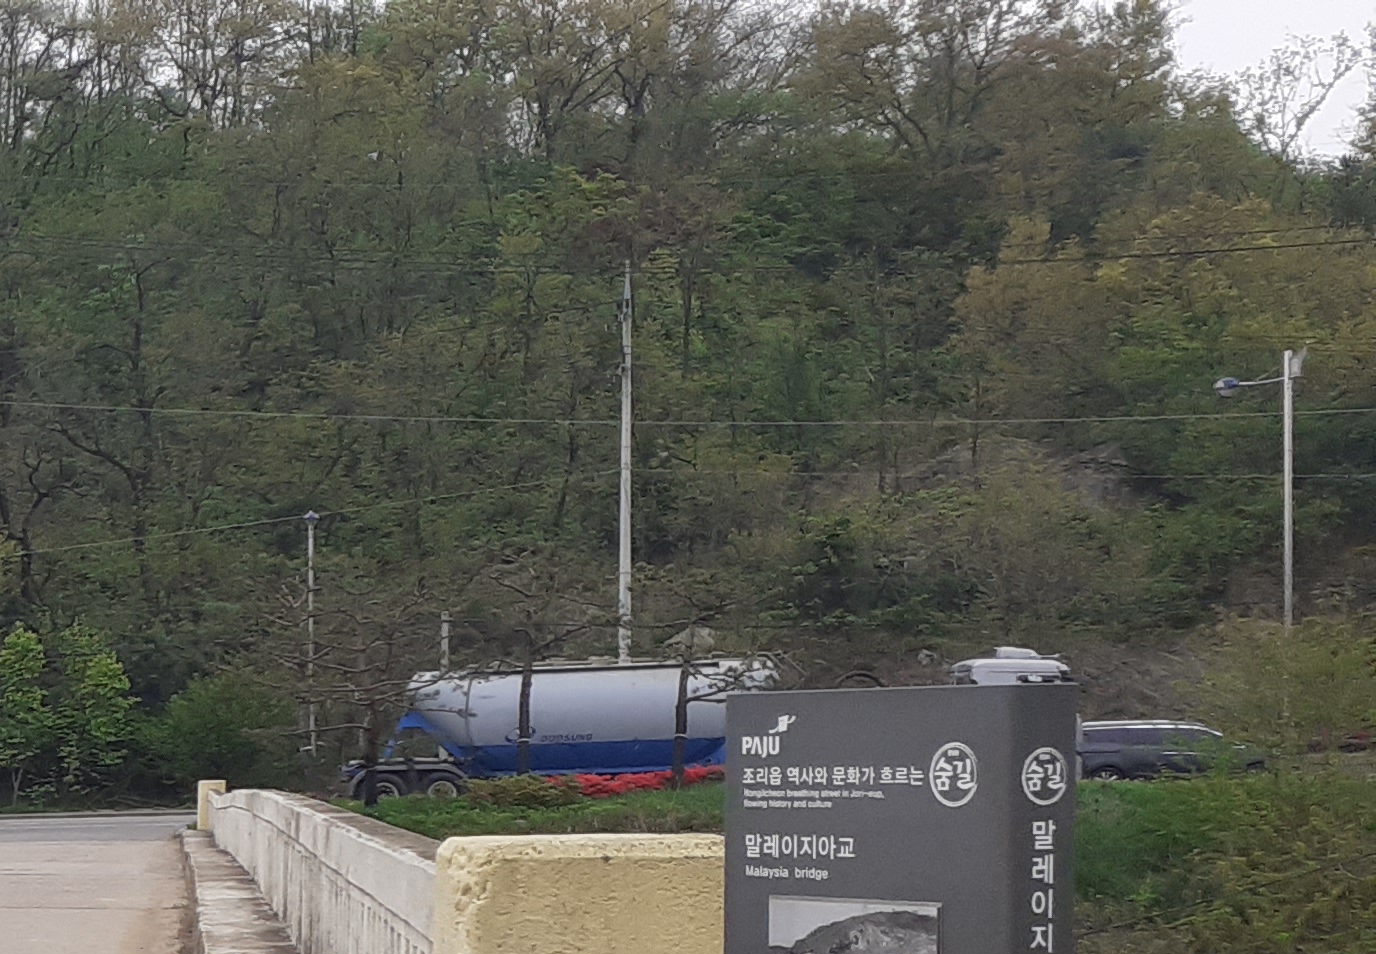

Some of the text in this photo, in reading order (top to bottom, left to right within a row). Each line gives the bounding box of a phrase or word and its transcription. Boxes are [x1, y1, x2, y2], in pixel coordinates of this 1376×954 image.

[742, 736, 781, 758] PAJU
[742, 766, 925, 786] 조리읍 역사와 문화가 흐르는
[934, 758, 976, 791] 숨길
[1026, 760, 1066, 791] 숨길
[745, 833, 856, 860] 말레이지아교
[745, 864, 829, 881] Malaysia bridge
